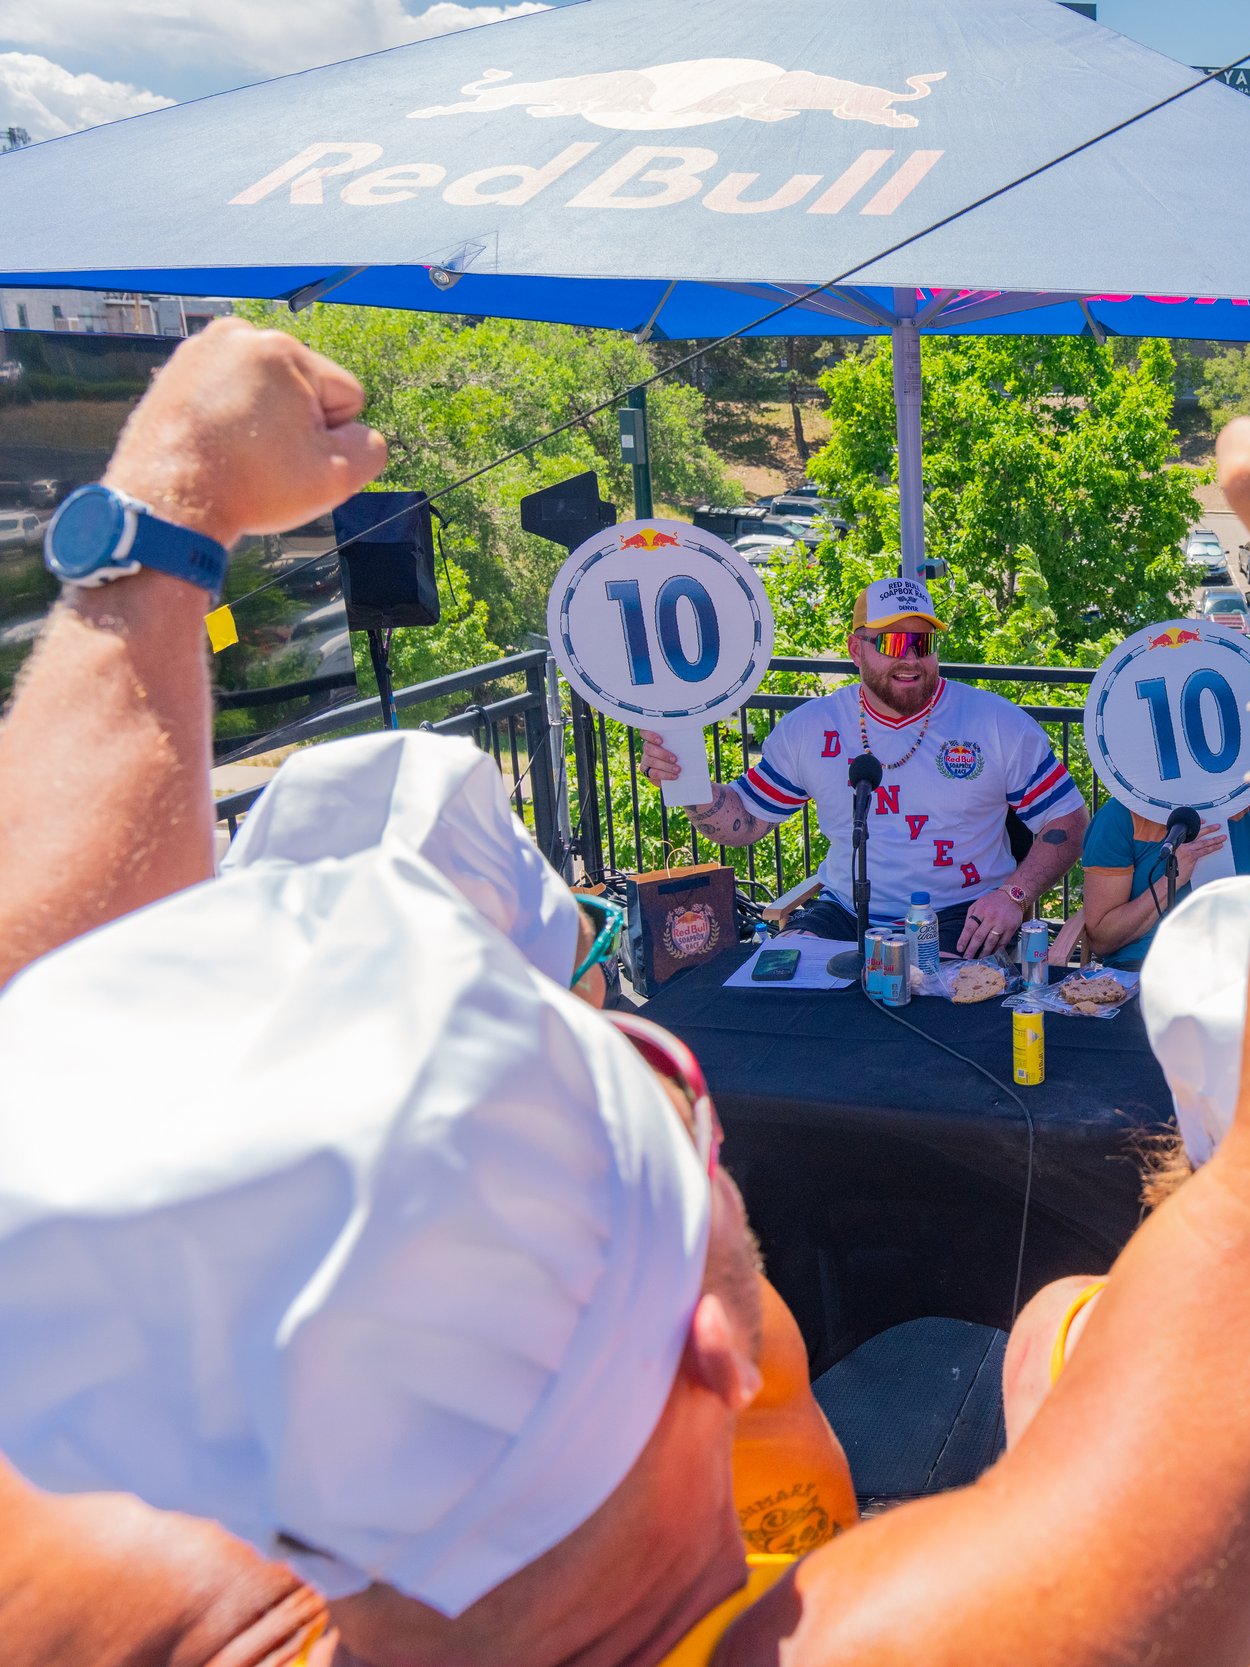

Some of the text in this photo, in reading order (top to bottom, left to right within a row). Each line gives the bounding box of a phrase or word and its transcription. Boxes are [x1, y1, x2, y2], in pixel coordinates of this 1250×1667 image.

[227, 141, 945, 216] Red Bull
[888, 581, 903, 590] RED
[880, 588, 930, 605] SOAPBOX RACE
[604, 574, 721, 686] 10
[1135, 668, 1242, 781] 10
[945, 755, 976, 764] Red Bull
[821, 730, 982, 888] DNVER
[674, 922, 708, 938] Red Bull
[685, 941, 700, 950] RACE
